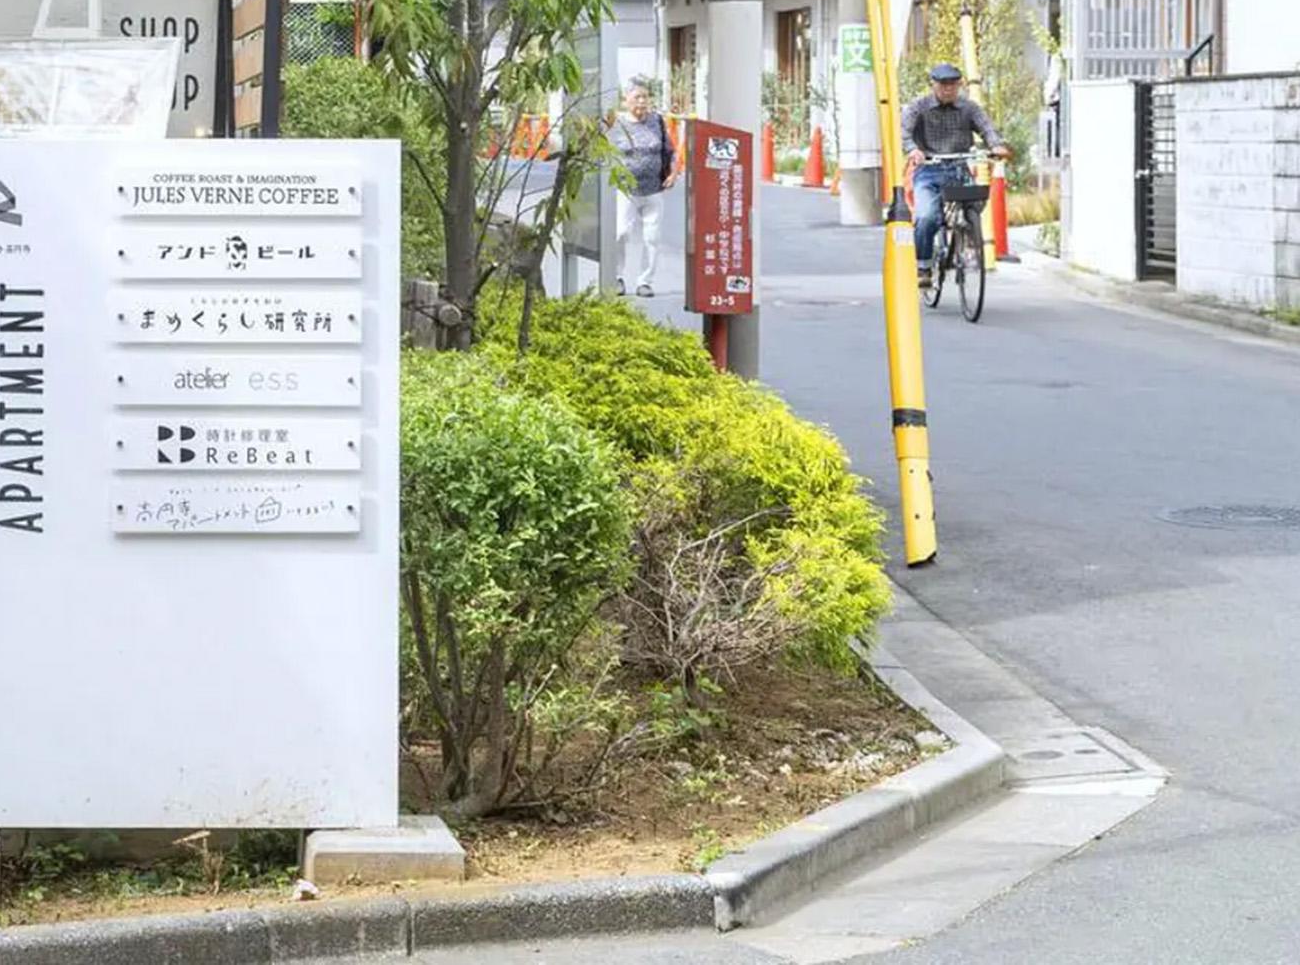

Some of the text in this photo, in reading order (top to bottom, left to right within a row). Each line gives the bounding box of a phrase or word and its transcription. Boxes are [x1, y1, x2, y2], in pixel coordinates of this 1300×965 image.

[152, 173, 317, 185] COFFEE ROAST & IMAGINATION
[132, 186, 339, 207] JULES VERNE COFFEE
[157, 245, 316, 260] アンド ビール
[140, 309, 332, 334] まめくらし研究所
[173, 367, 299, 391] atelier ess
[206, 447, 313, 465] ReBeat
